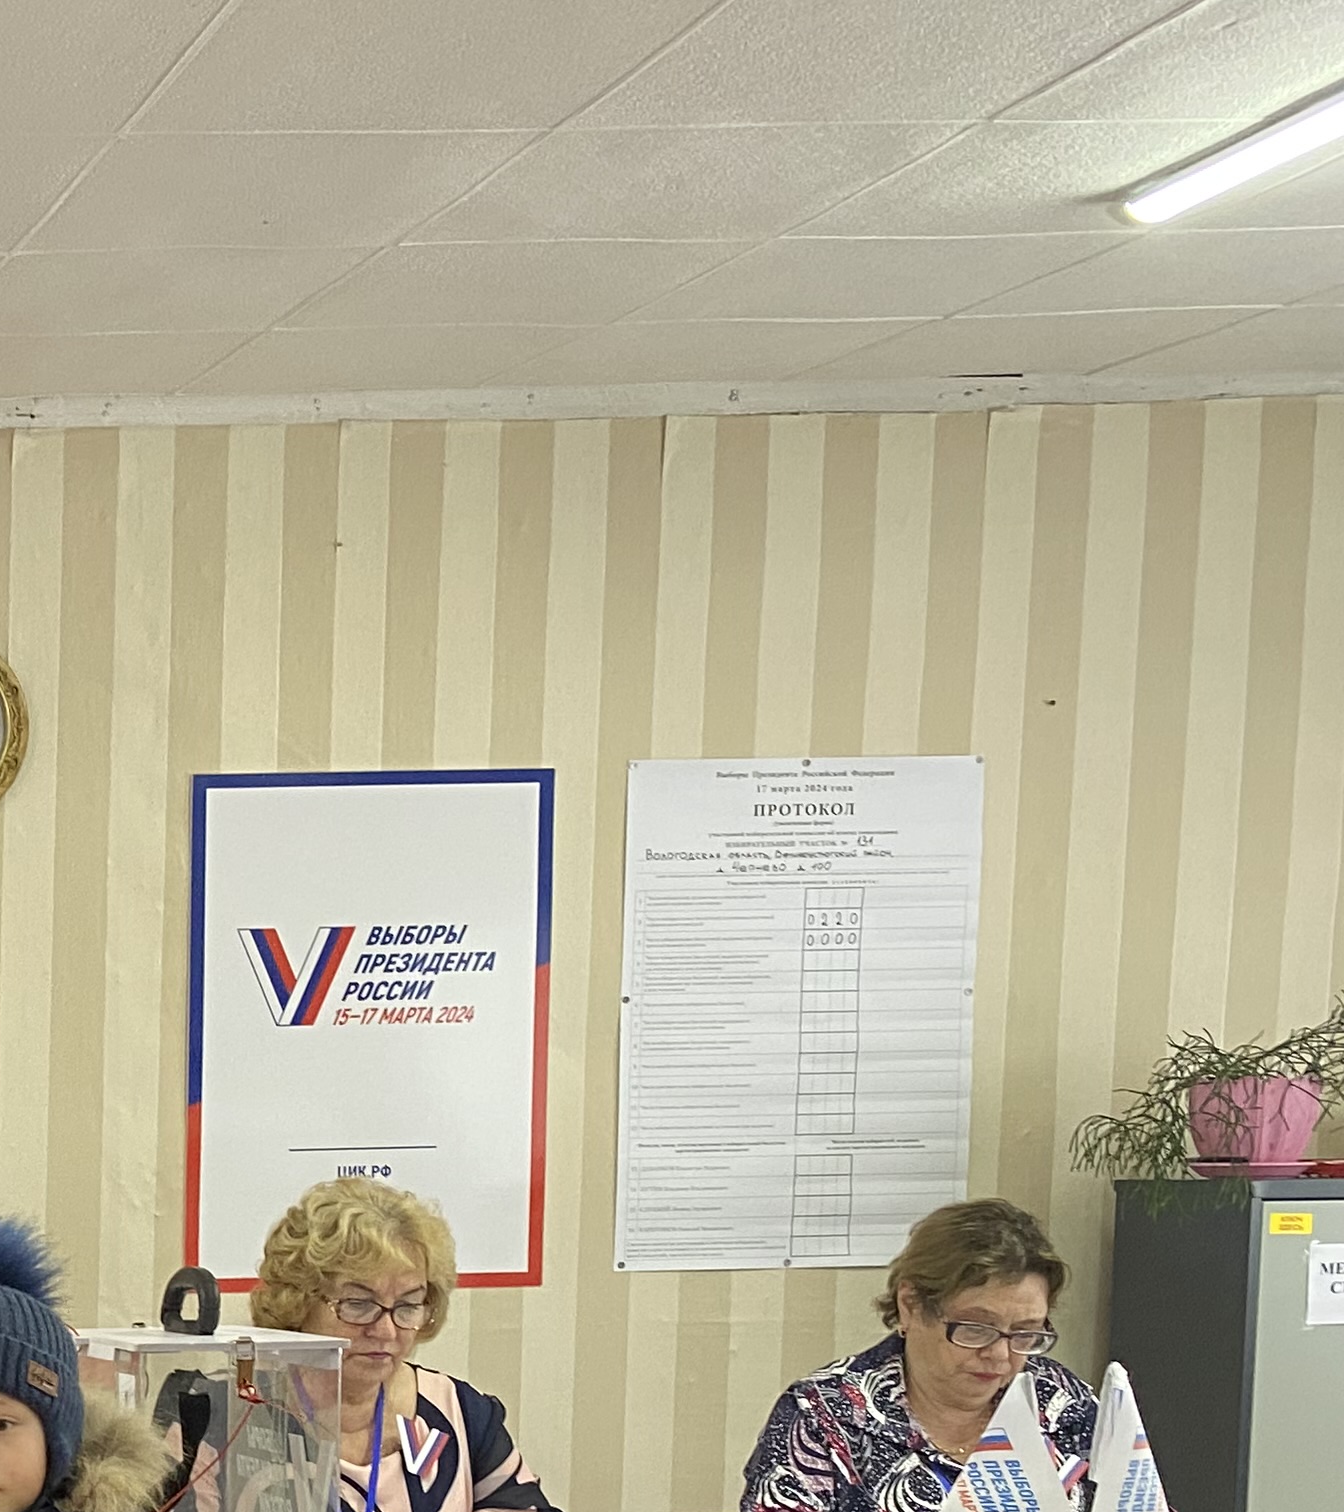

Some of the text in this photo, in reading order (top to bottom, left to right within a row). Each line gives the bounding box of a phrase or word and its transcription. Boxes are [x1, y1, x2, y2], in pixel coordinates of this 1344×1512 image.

[804, 784, 828, 792] 2024
[754, 802, 855, 817] ПРОТОКОЛ
[366, 924, 468, 946] ВЫБОРЫ
[354, 951, 496, 975] ПРЕЗИДЕНТА
[342, 980, 435, 1002] РОССИИ
[378, 1007, 433, 1025] МАРТА
[436, 1006, 475, 1023] 2024
